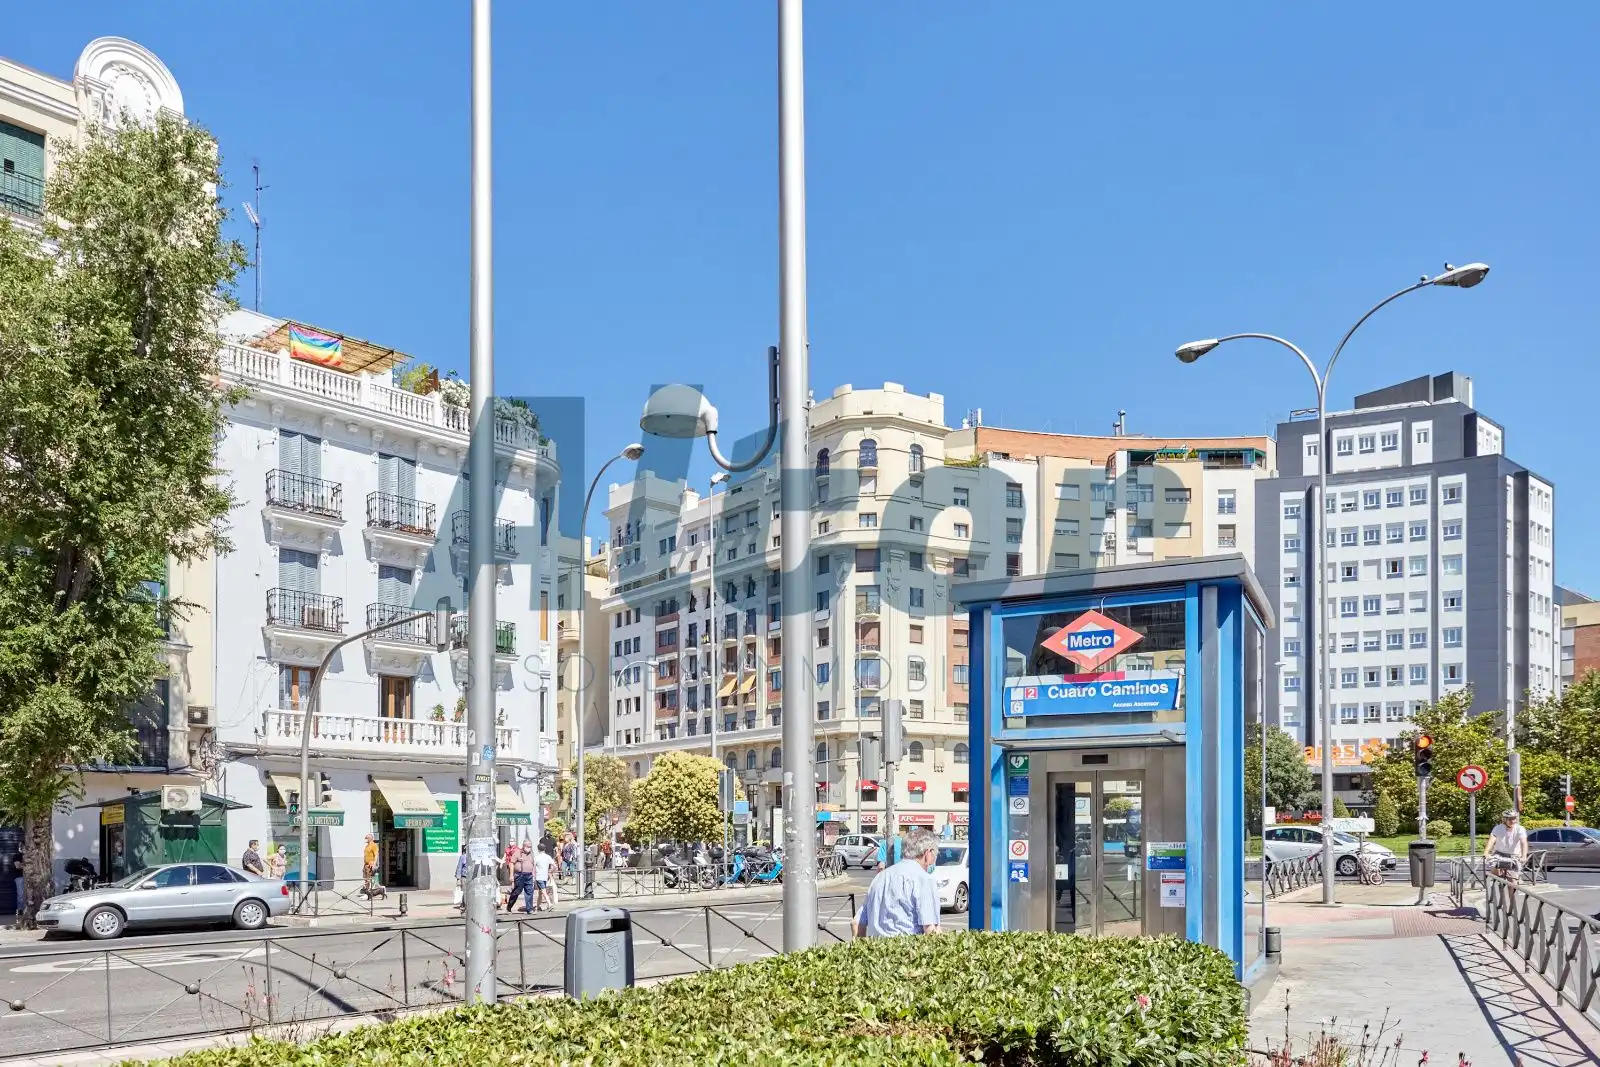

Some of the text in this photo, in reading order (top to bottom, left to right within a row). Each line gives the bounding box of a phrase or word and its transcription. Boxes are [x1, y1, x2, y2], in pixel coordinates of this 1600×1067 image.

[1069, 634, 1112, 648] Metro
[1027, 688, 1035, 698] 2
[1047, 682, 1169, 700] Cuatro Caminos
